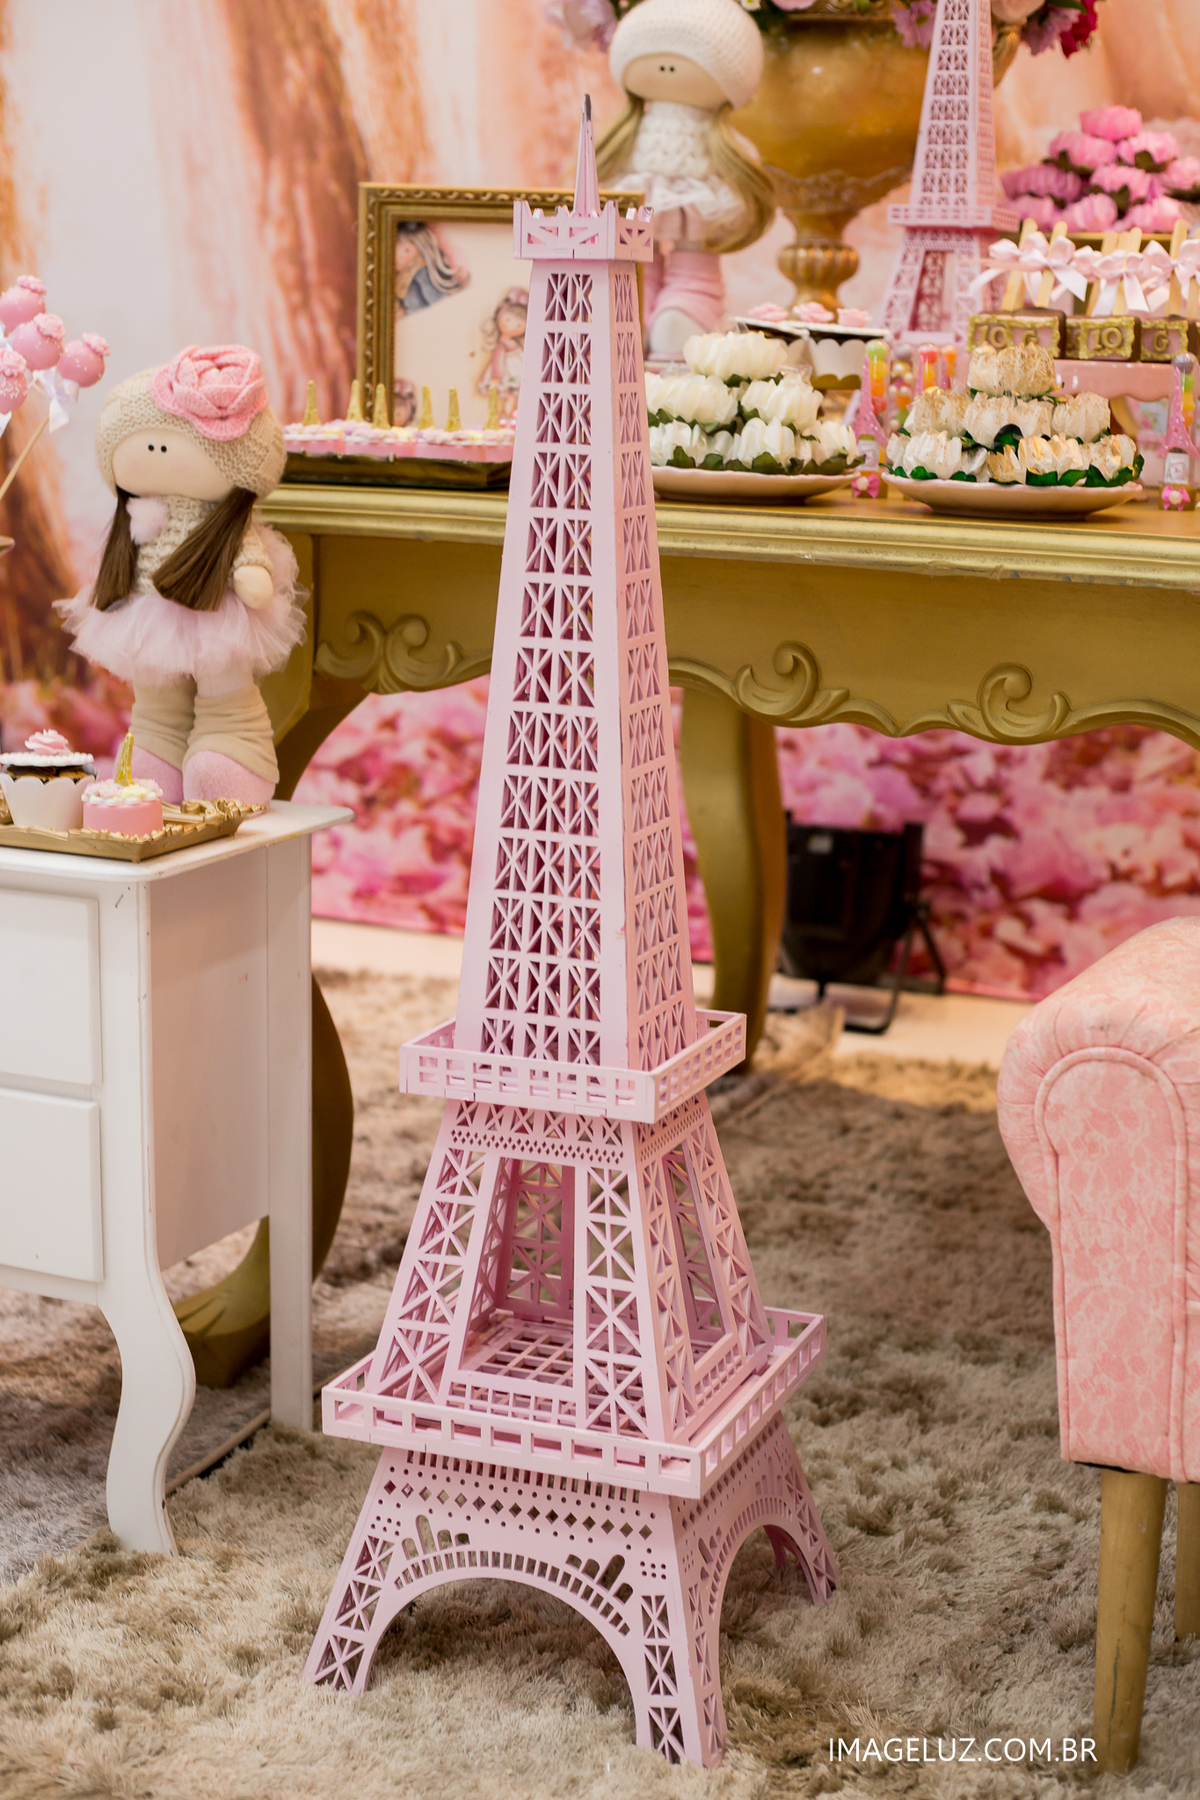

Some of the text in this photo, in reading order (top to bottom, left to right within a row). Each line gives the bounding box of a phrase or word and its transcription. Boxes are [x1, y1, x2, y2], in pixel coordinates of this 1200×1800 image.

[977, 325, 1007, 348] 10
[1091, 326, 1123, 350] 10
[1152, 329, 1169, 352] G
